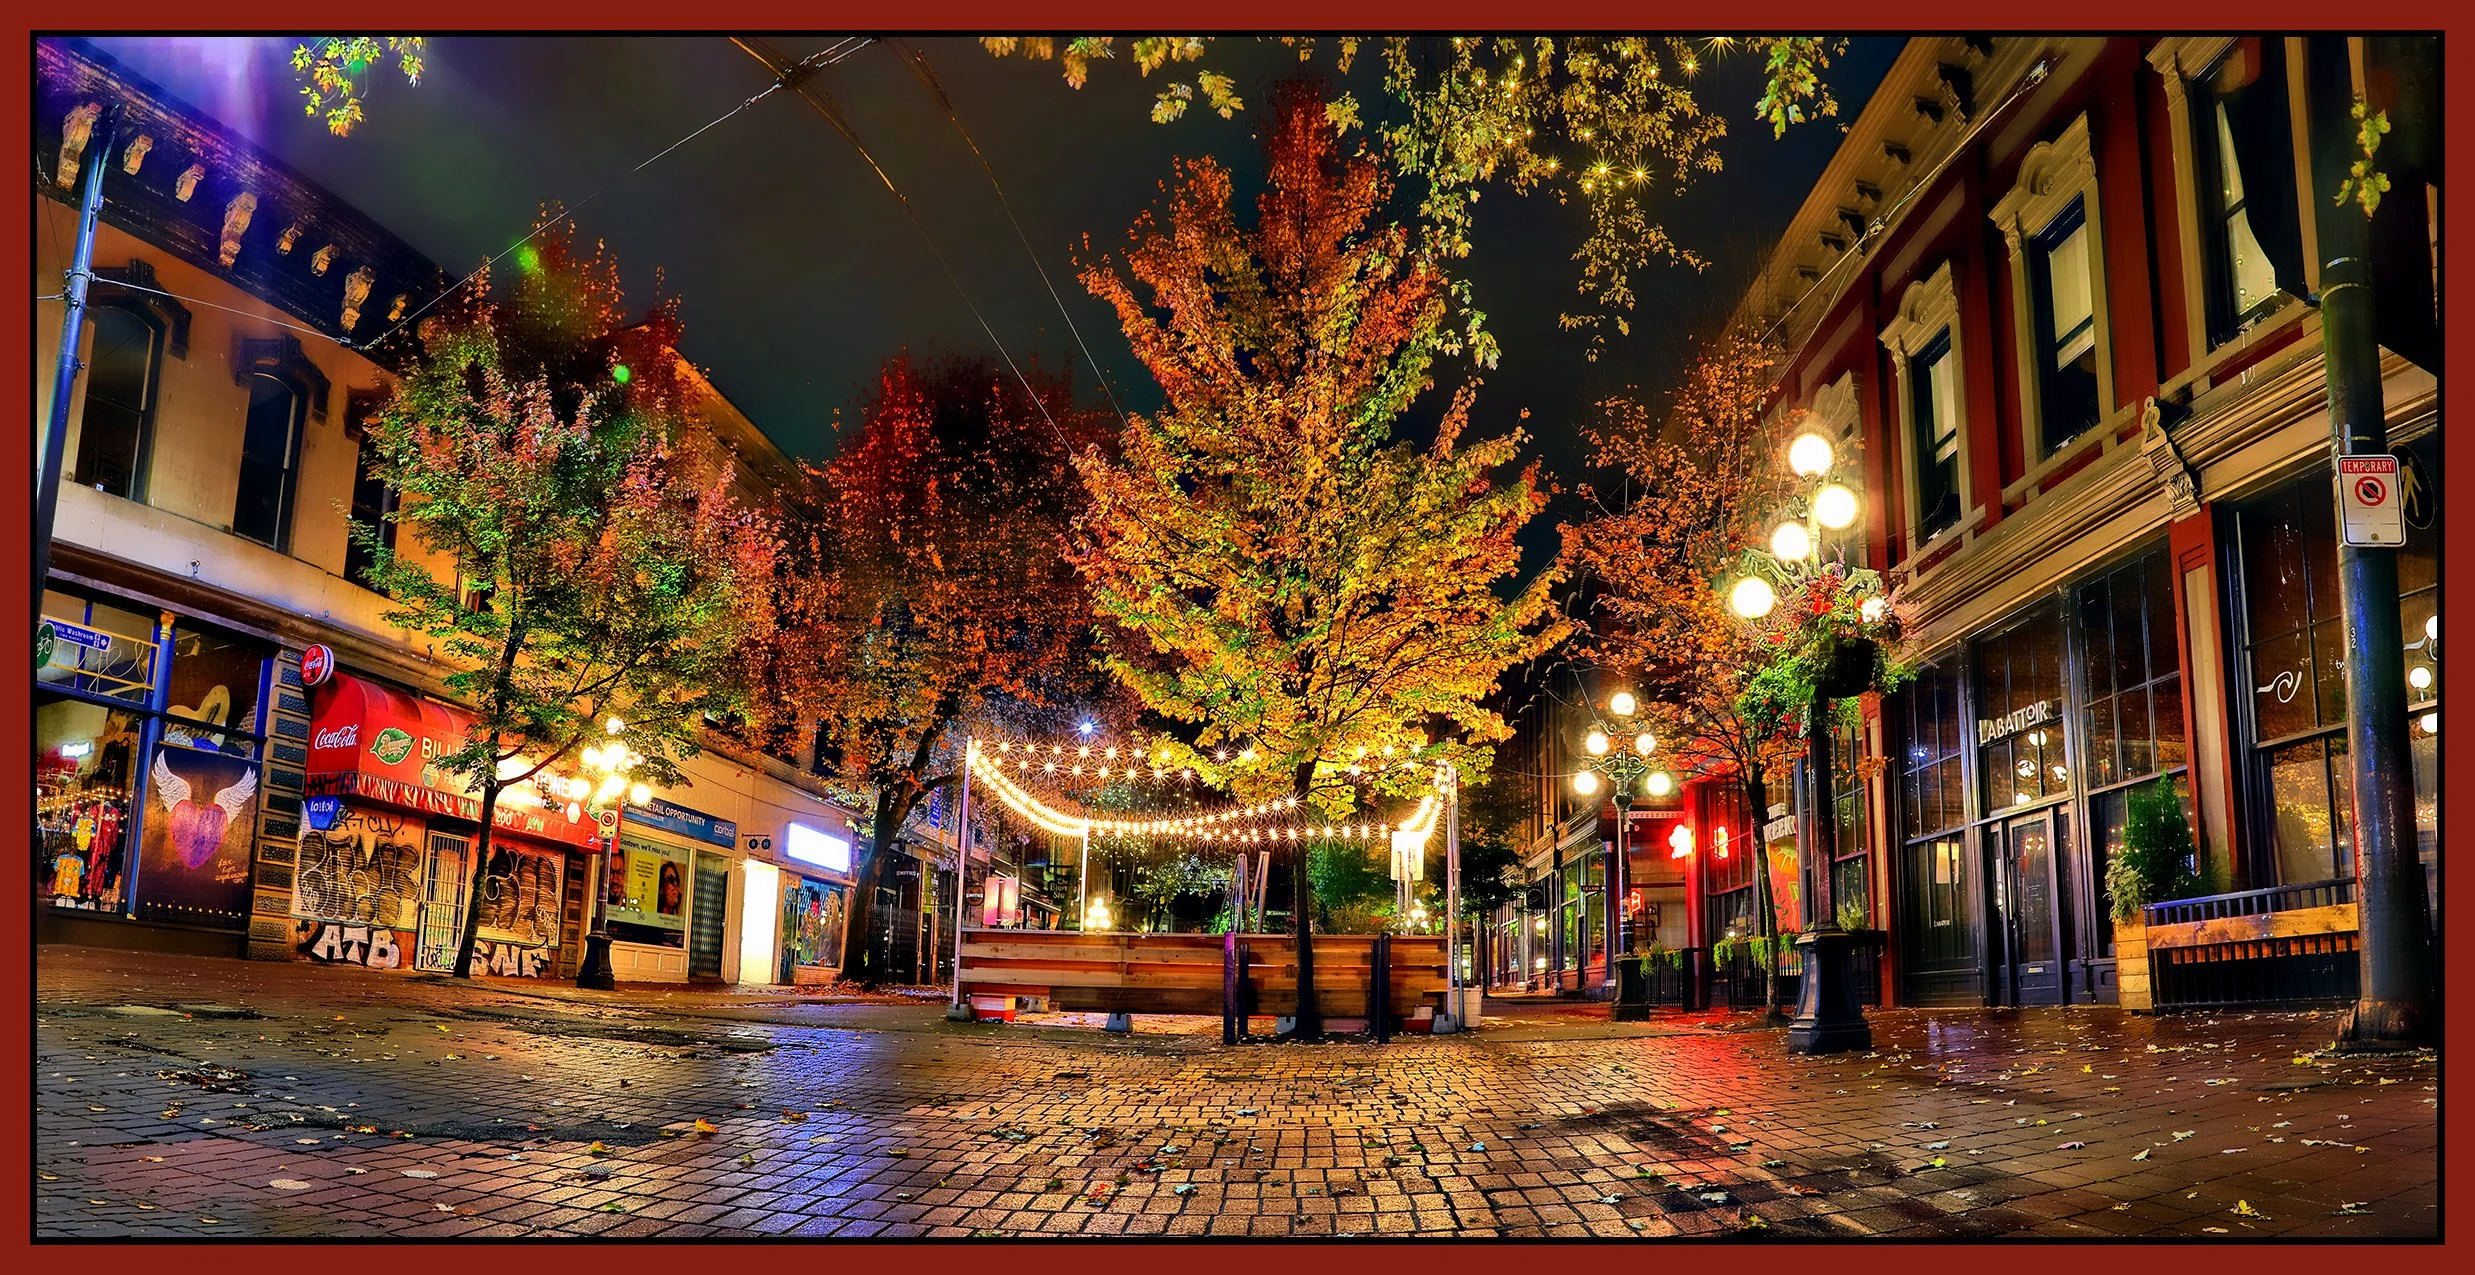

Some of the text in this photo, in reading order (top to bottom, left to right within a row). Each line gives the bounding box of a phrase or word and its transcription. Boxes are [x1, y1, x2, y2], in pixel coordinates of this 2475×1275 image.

[2342, 461, 2393, 472] TEMPORARY
[67, 627, 94, 640] Washroom
[2350, 628, 2357, 649] 32
[1979, 700, 2049, 744] L'ABATTOIR
[665, 807, 706, 827] OPPORTUNITY
[620, 838, 640, 850] Gastown,
[641, 844, 652, 852] we'll
